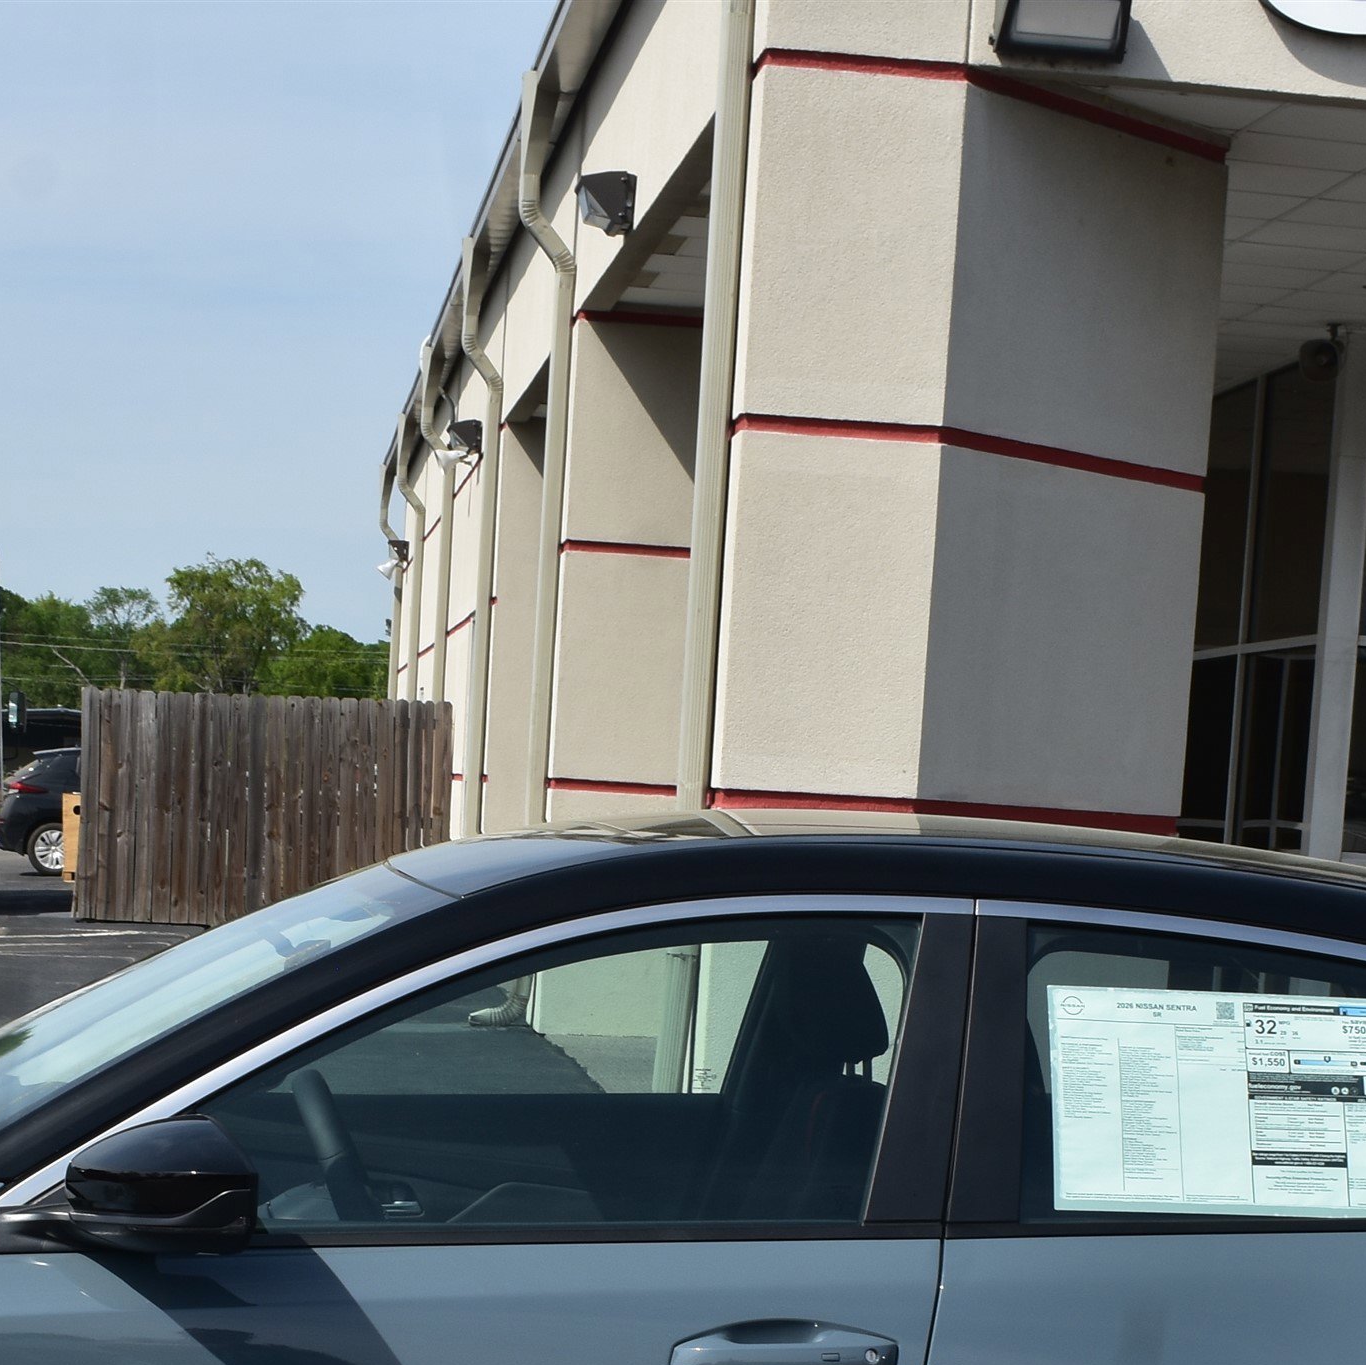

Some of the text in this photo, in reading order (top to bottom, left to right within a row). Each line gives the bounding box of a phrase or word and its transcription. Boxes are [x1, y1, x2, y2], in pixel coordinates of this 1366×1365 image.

[1116, 1001, 1197, 1012] 2026 NISSAN SENTRA
[1255, 1019, 1277, 1035] 32
[1342, 1025, 1366, 1035] $750
[1251, 1056, 1286, 1067] $1,550
[1248, 1083, 1302, 1091] fueleconomy.gov
